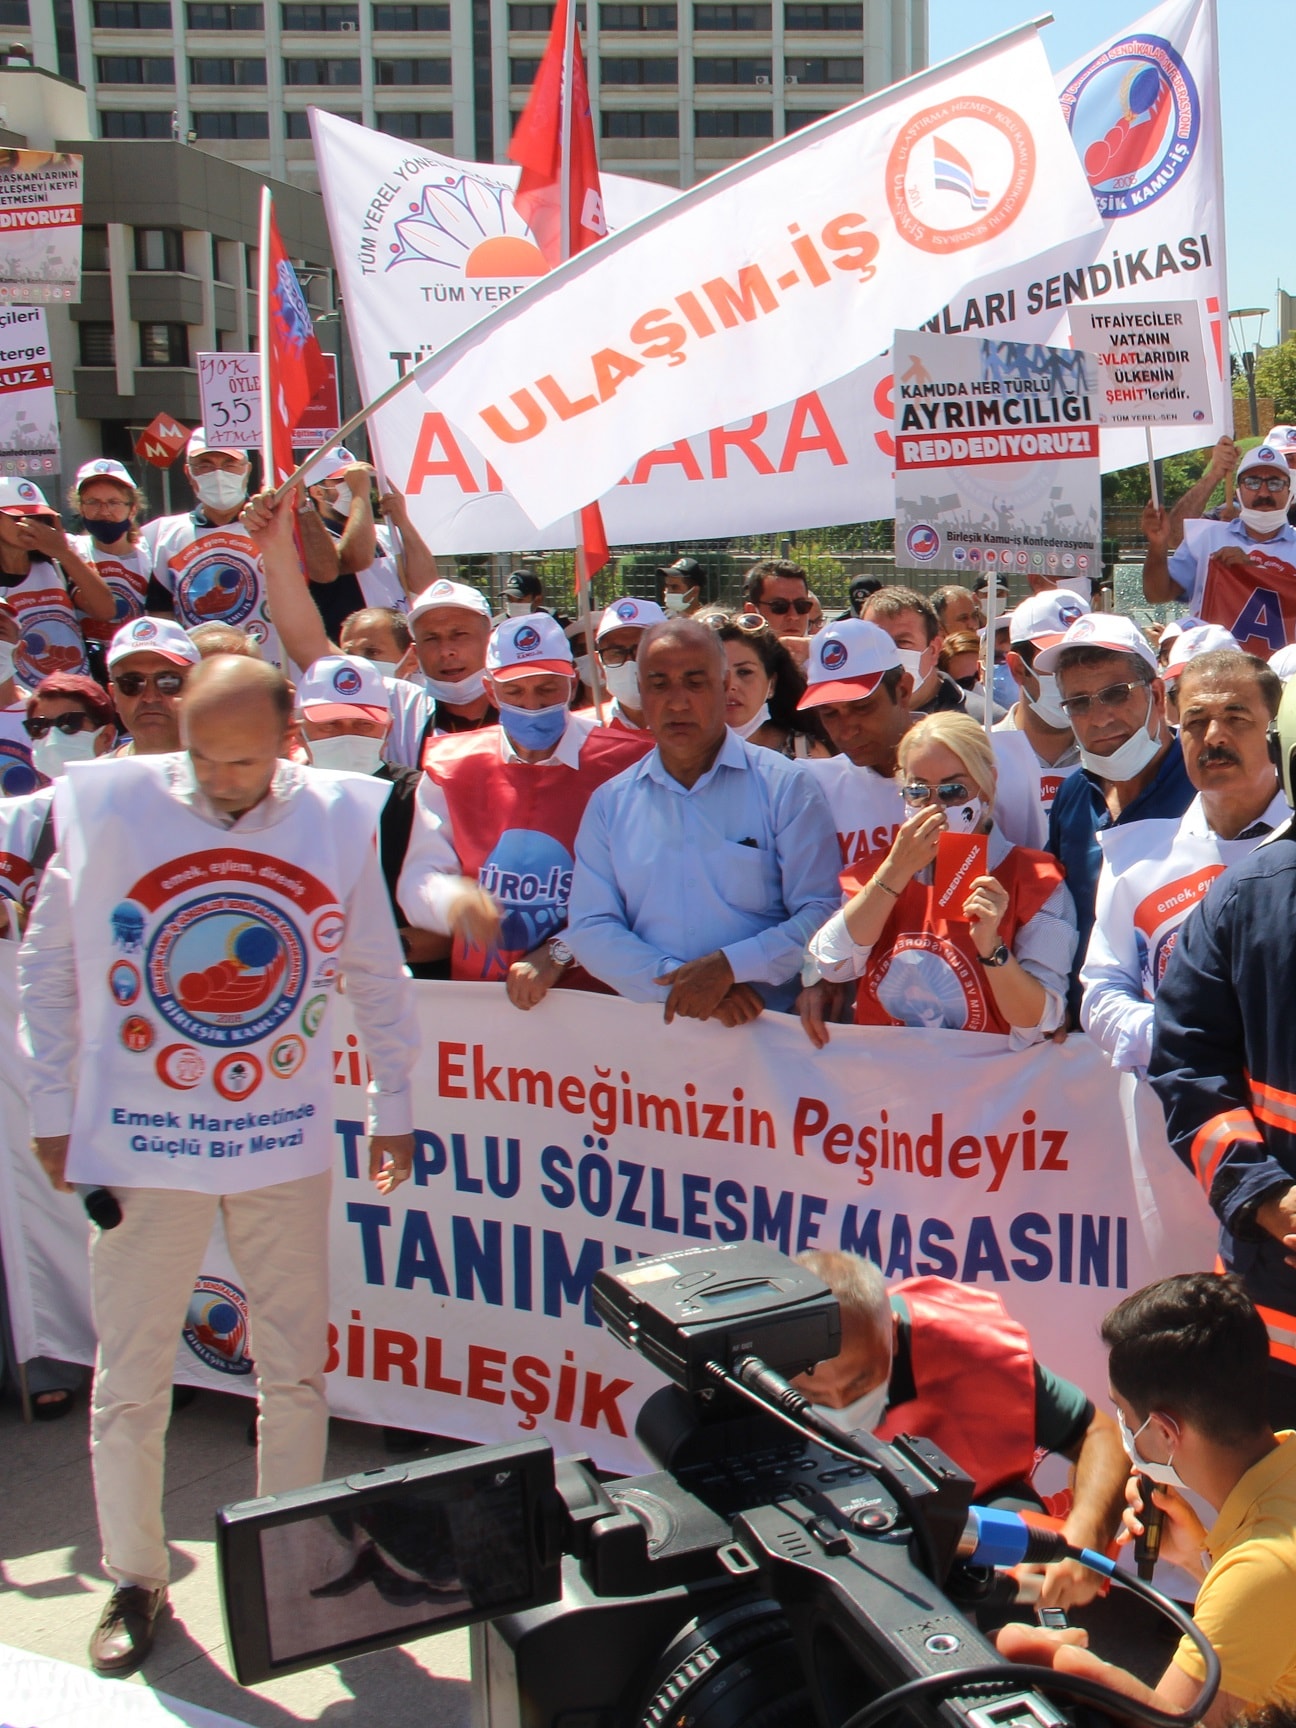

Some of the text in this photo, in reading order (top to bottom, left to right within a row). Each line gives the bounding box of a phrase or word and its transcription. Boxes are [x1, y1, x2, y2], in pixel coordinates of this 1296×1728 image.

[1108, 41, 1166, 60] SENDİKALAR
[898, 108, 949, 160] ULAŞTIRMA
[951, 101, 996, 116] HİZMET
[50, 181, 78, 191] KEYFİ
[1112, 175, 1138, 189] 2008
[1130, 143, 1190, 206] KAMU-İŞ
[363, 185, 401, 231] YEREL
[359, 235, 377, 275] TÜM
[1026, 233, 1212, 316] SENDİKASI
[420, 283, 530, 302] TÜM YERE
[478, 212, 880, 445] ULAŞIM-İŞ
[1091, 311, 1183, 329] İTFAİYECİLER
[1110, 332, 1170, 346] VATANIN
[1, 345, 46, 362] terge
[201, 358, 249, 384] YOK
[1114, 367, 1174, 383] ÜLKENİN
[901, 376, 1050, 398] KAMUDA HER TÜRLÜ
[902, 391, 1091, 431] AYRIMCILIĞI
[1111, 414, 1131, 422] TÜM
[159, 422, 183, 438] M
[144, 441, 169, 458] M
[947, 531, 1094, 550] Birleşik Kamu-iş Konfederasyonu
[160, 860, 307, 896] emek, eylem, direniş
[938, 844, 981, 908] REDEDİYORUZ
[1157, 887, 1197, 914] emek,
[160, 1000, 228, 1041] BİRLEŞİK
[112, 1102, 316, 1132] Emek Hareketinde
[437, 1040, 777, 1150] Ekmeğimizin
[792, 1095, 1070, 1193] Peşindeyiz
[130, 1128, 304, 1158] Güçlü Bir Mevzi
[335, 1118, 522, 1199] TPLU
[840, 1203, 1129, 1290] MASASINI
